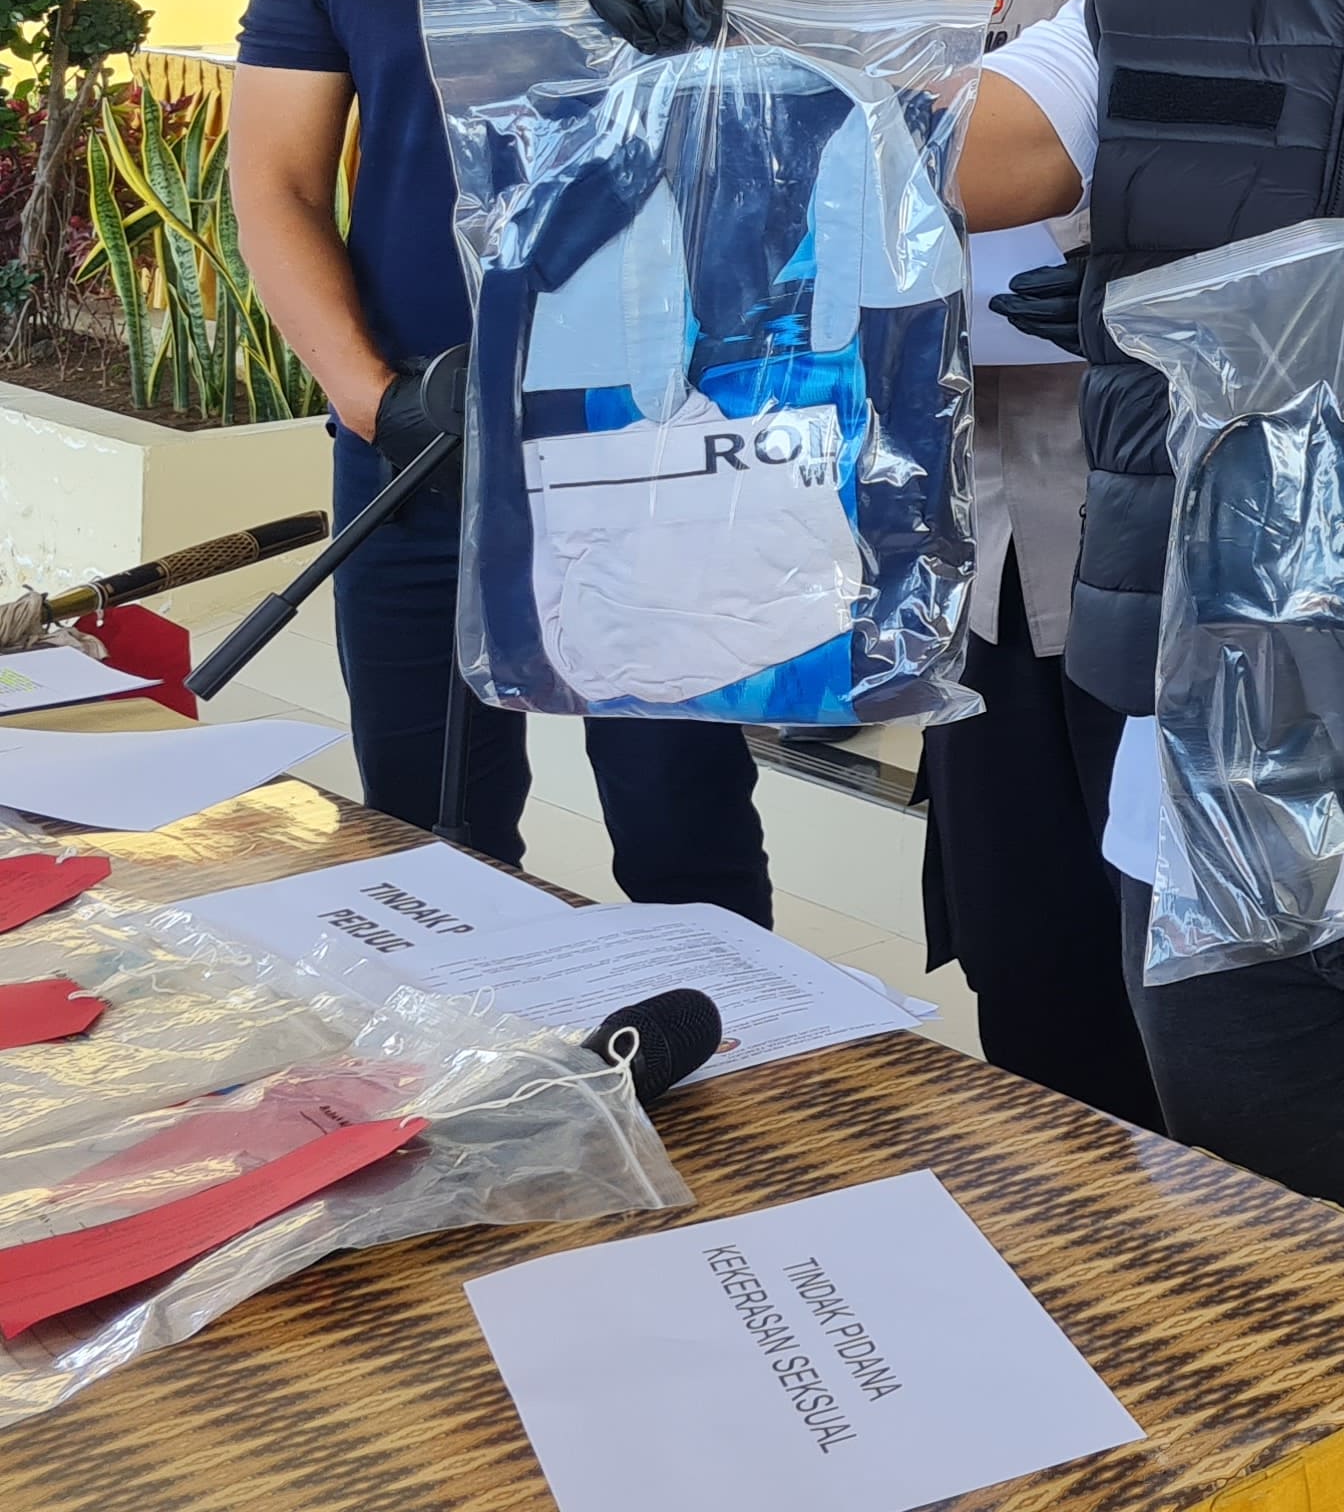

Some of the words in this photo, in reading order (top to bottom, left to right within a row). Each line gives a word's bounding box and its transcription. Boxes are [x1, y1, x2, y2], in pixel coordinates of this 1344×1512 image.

[359, 882, 460, 929] TINDAK
[702, 1244, 801, 1355] KEKERASAN
[772, 1355, 858, 1454] SEKSUAL
[782, 1256, 856, 1326] TINDAK
[825, 1322, 904, 1402] PIDANA
